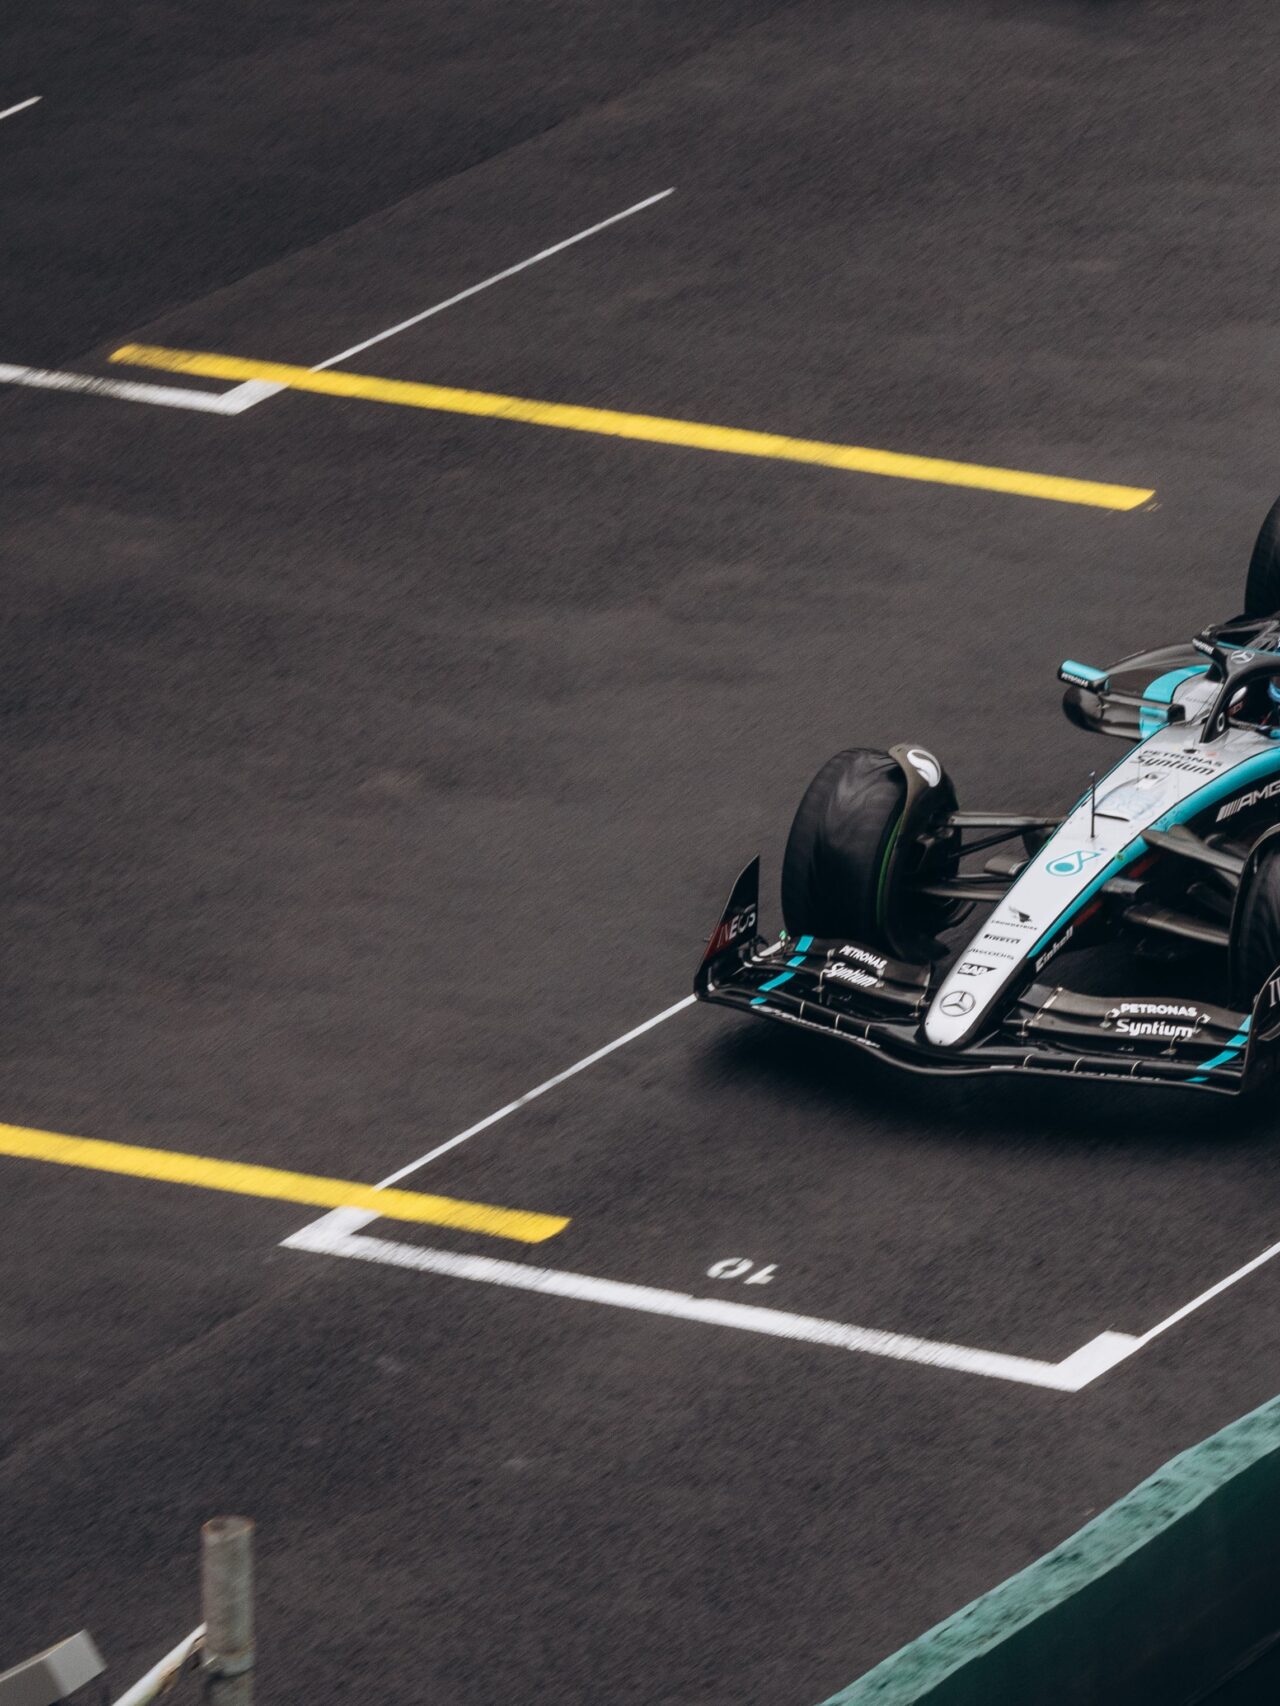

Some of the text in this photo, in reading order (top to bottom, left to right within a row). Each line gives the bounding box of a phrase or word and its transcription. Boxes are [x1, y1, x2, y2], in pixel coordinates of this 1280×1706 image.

[838, 944, 888, 970] PETRONAS
[958, 963, 990, 976] SAP
[1119, 1002, 1198, 1018] PETRONAS
[1115, 1018, 1194, 1038] Syntium
[706, 1257, 779, 1285] 10
